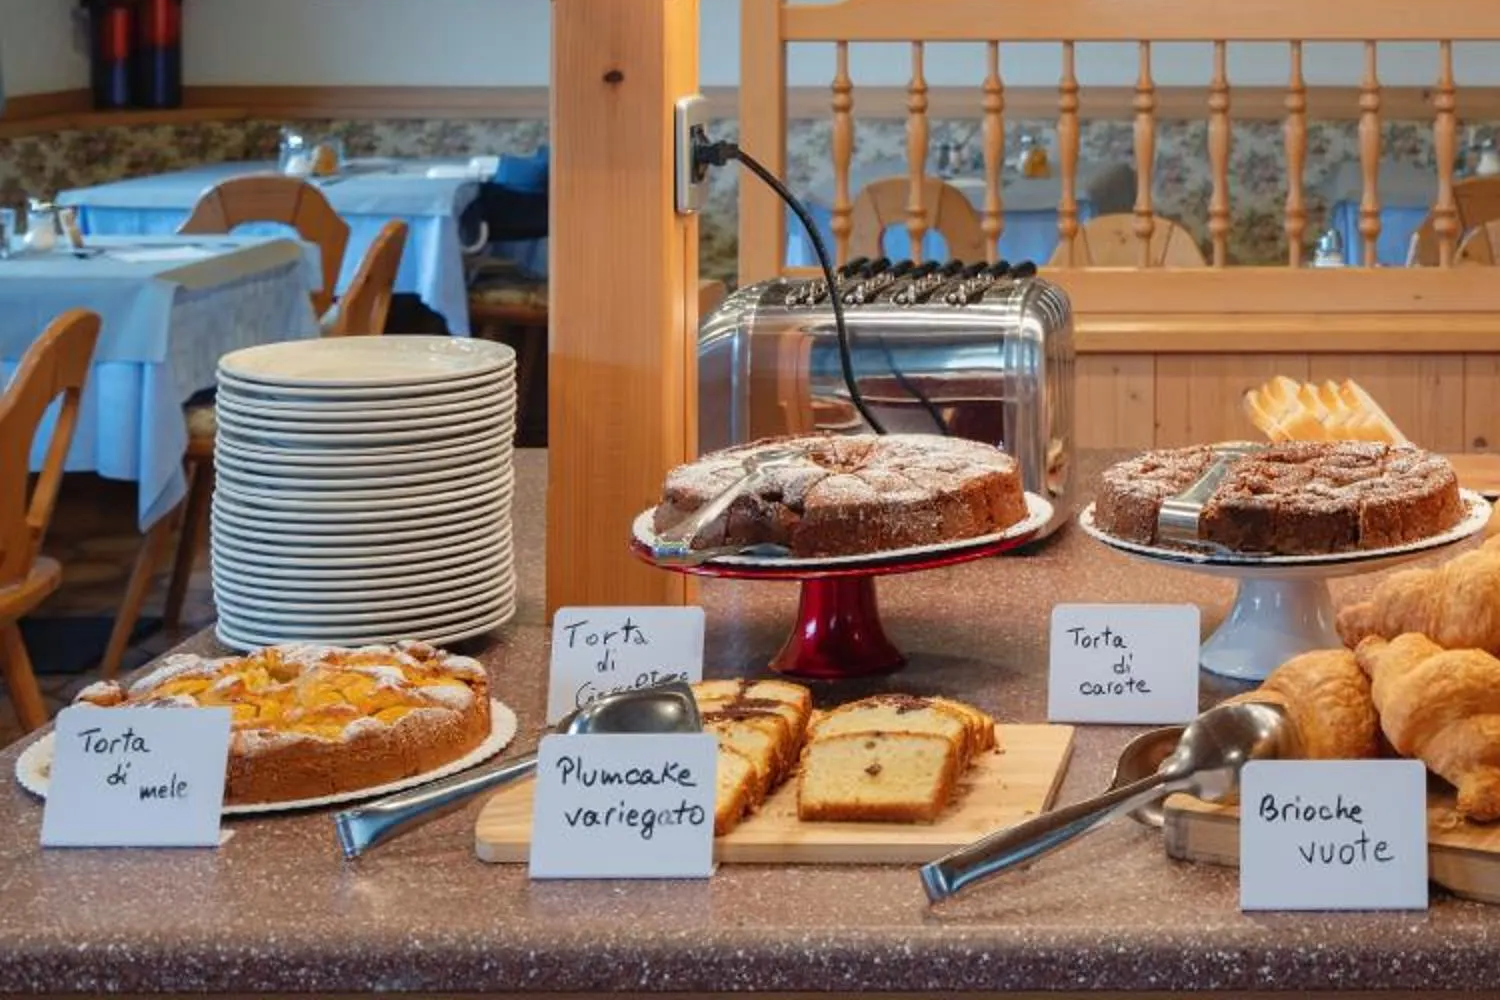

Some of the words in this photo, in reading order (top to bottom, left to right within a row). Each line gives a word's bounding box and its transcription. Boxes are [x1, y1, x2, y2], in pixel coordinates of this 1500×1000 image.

[564, 616, 648, 649] Torta
[1066, 625, 1128, 649] Torta
[596, 648, 617, 673] di
[1112, 652, 1133, 675] di
[1079, 677, 1152, 695] carote
[77, 727, 152, 753] Torta
[106, 761, 132, 786] di
[556, 755, 697, 788] Plumcake
[139, 772, 188, 801] mele
[564, 800, 706, 841] variegato
[1259, 793, 1364, 824] Brioche
[1298, 828, 1395, 866] vuote
